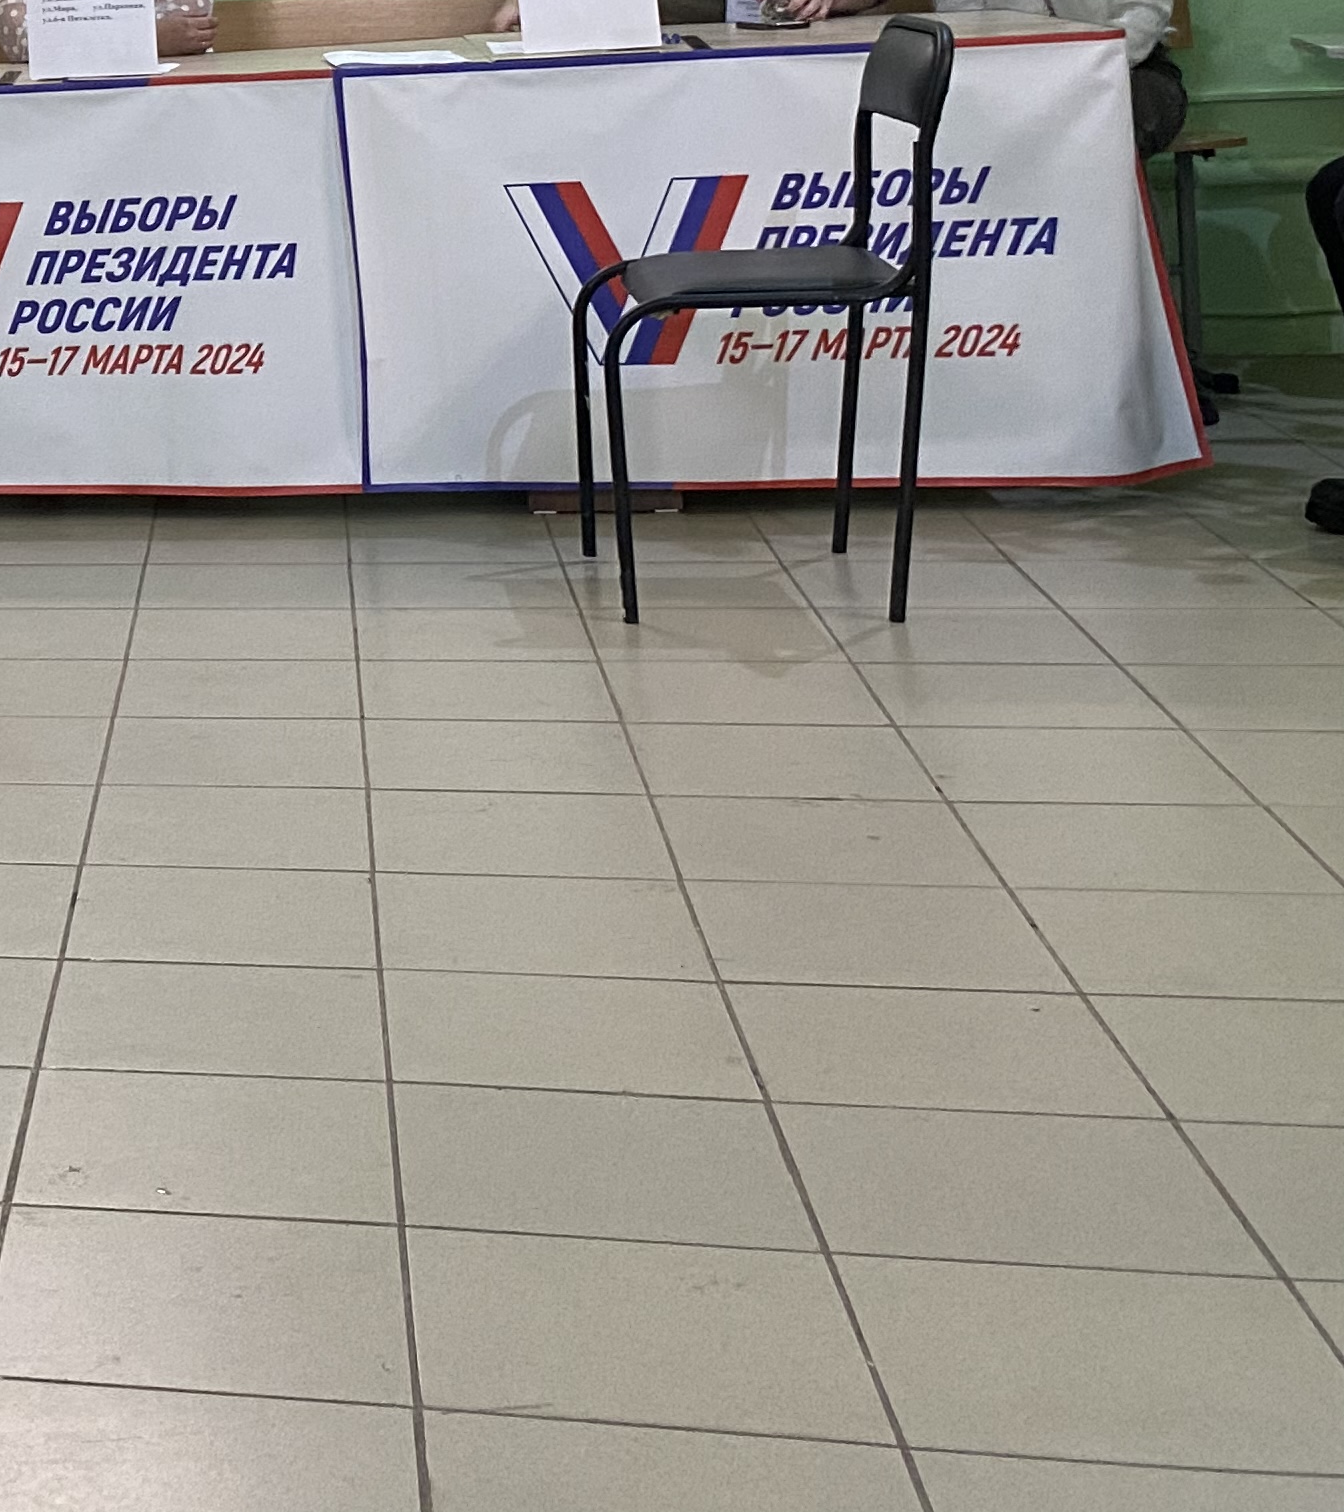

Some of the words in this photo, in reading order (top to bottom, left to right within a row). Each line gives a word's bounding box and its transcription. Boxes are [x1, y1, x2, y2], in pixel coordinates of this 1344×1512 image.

[43, 194, 237, 236] ВЫБОРЫ
[26, 242, 298, 287] ПРЕЗИДЕНТА
[8, 295, 182, 335] РОССИИ
[81, 343, 184, 376] МАРТА
[189, 342, 265, 375] 2024
[933, 323, 1021, 359] 2024
